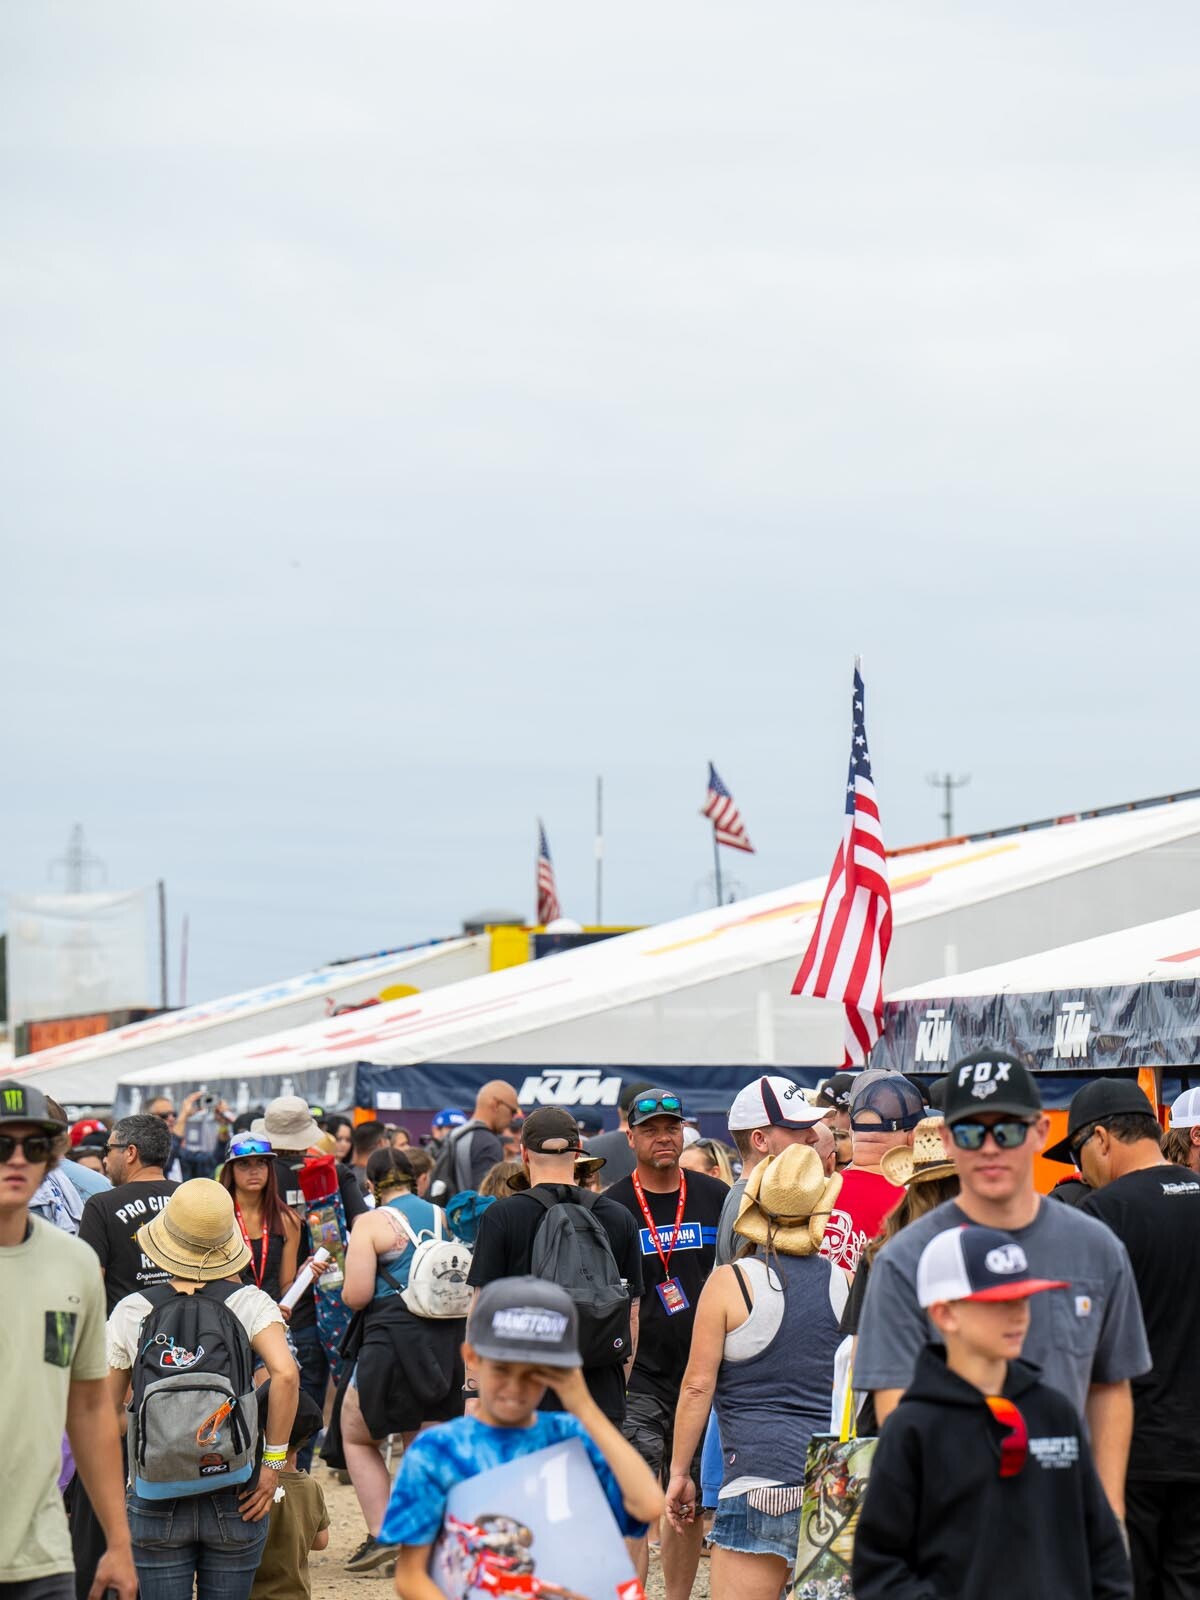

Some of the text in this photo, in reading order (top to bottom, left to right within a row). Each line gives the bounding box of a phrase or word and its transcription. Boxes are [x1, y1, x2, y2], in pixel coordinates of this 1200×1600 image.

[915, 1009, 952, 1061] KTM
[1053, 1002, 1092, 1058] KTM
[518, 1069, 622, 1106] KTM
[958, 1061, 1012, 1087] FOX
[115, 1199, 147, 1224] PRO
